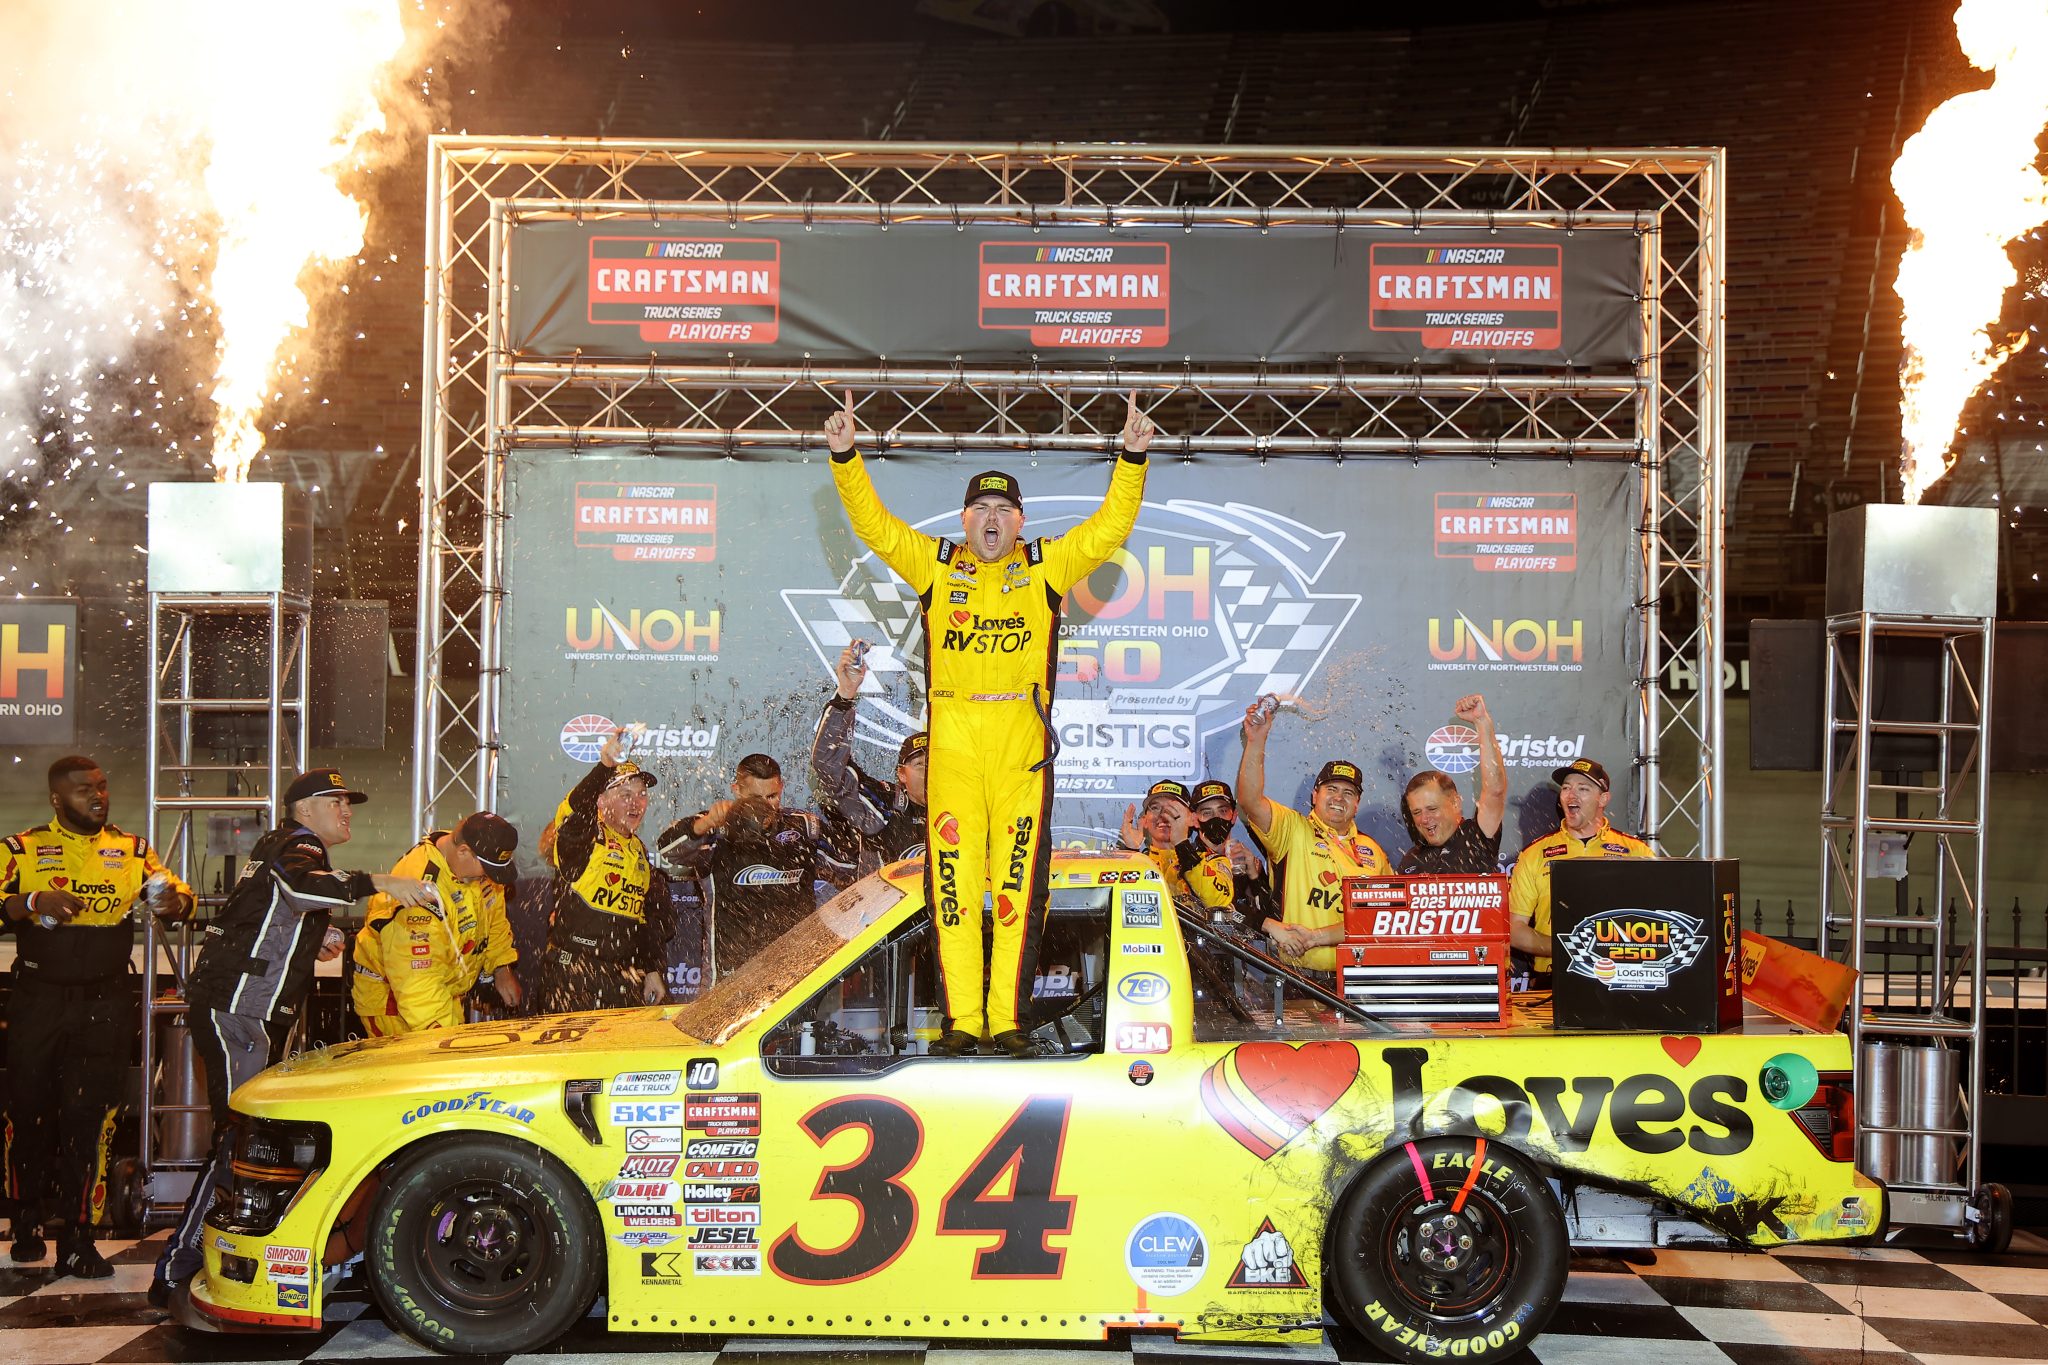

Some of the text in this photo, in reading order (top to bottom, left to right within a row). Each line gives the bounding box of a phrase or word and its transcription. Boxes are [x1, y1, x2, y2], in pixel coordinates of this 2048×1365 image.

[664, 243, 723, 258] NASCAR
[1054, 248, 1113, 262] NASCAR
[1445, 249, 1505, 264] NASCAR
[597, 268, 769, 294] CRAFTSMAN
[987, 274, 1159, 298] CRAFTSMAN
[1378, 275, 1551, 299] CRAFTSMAN
[644, 306, 722, 319] TRUCK SERIES
[1034, 311, 1112, 324] TRUCK SERIES
[1425, 313, 1504, 325] TRUCK SERIES
[668, 324, 752, 340] PLAYOFFS
[1059, 328, 1143, 344] PLAYOFFS
[1450, 330, 1534, 346] PLAYOFFS
[631, 487, 675, 498] NASCAR
[1490, 497, 1535, 508] NASCAR
[580, 506, 709, 525] CRAFTSMAN
[1440, 516, 1569, 535] CRAFTSMAN
[616, 534, 674, 544] TRUCK SERIES
[634, 547, 696, 559] PLAYOFFS
[1476, 544, 1534, 554] TRUCK SERIES
[1495, 558, 1557, 569] PLAYOFFS
[1062, 546, 1210, 621] OH
[565, 598, 721, 652] UNOH
[1058, 625, 1209, 638] ORTHWESTERN OHIO
[1428, 608, 1583, 662] UNOH
[627, 653, 696, 661] NORTHWESTERN
[697, 654, 719, 662] OHIO
[1057, 640, 1161, 682] 50
[1428, 663, 1477, 671] UNIVERSITY
[1478, 663, 1489, 671] OF
[1561, 664, 1582, 672] OHIO
[1115, 694, 1192, 706] Presented by
[24, 704, 63, 716] OHIO
[1059, 723, 1191, 749] GISTICS
[1495, 734, 1585, 757] Bristol
[656, 748, 714, 759] Speedway
[1053, 757, 1191, 770] ousing & Transportation
[1503, 759, 1518, 767] tor
[1521, 758, 1576, 769] Speedwa
[1605, 844, 1625, 852] Ford
[751, 872, 781, 880] FRONT
[1352, 891, 1406, 899] CRAFTSMAN
[1410, 882, 1502, 895] CRAFTSMAN
[1126, 894, 1156, 904] BUILT
[1410, 895, 1502, 909] 2025 WINNER
[1127, 914, 1158, 925] TOUGH
[1372, 910, 1483, 935] BRISTOL
[1595, 917, 1669, 943] UNOH
[1122, 943, 1150, 953] Mobil
[1609, 947, 1656, 960] 250
[1617, 970, 1664, 978] LOGISTICS
[1119, 1026, 1168, 1050] SEM
[692, 1062, 717, 1085] 10
[1132, 1064, 1150, 1078] 52
[635, 1074, 671, 1082] NASCAR
[402, 1092, 536, 1125] GOODYEAR
[614, 1105, 680, 1122] SKF
[688, 1107, 756, 1117] CRAFTSMAN
[717, 1127, 750, 1135] PLAYOFFS
[688, 1142, 757, 1156] COMETIC
[626, 1159, 676, 1173] KLOTZ
[685, 1161, 759, 1178] CALICO
[684, 1184, 759, 1203] Holley EFI
[767, 1093, 1078, 1286] 34
[618, 1207, 671, 1216] LINCOLN
[691, 1208, 755, 1223] tilton
[629, 1218, 676, 1226] WELDERS
[624, 1232, 644, 1240] FIVE
[688, 1228, 757, 1244] JESEL
[1139, 1236, 1195, 1252] CLEW
[266, 1247, 308, 1262] SIMPSON
[269, 1264, 308, 1274] ARP
[279, 1292, 307, 1300] SUNOCO
